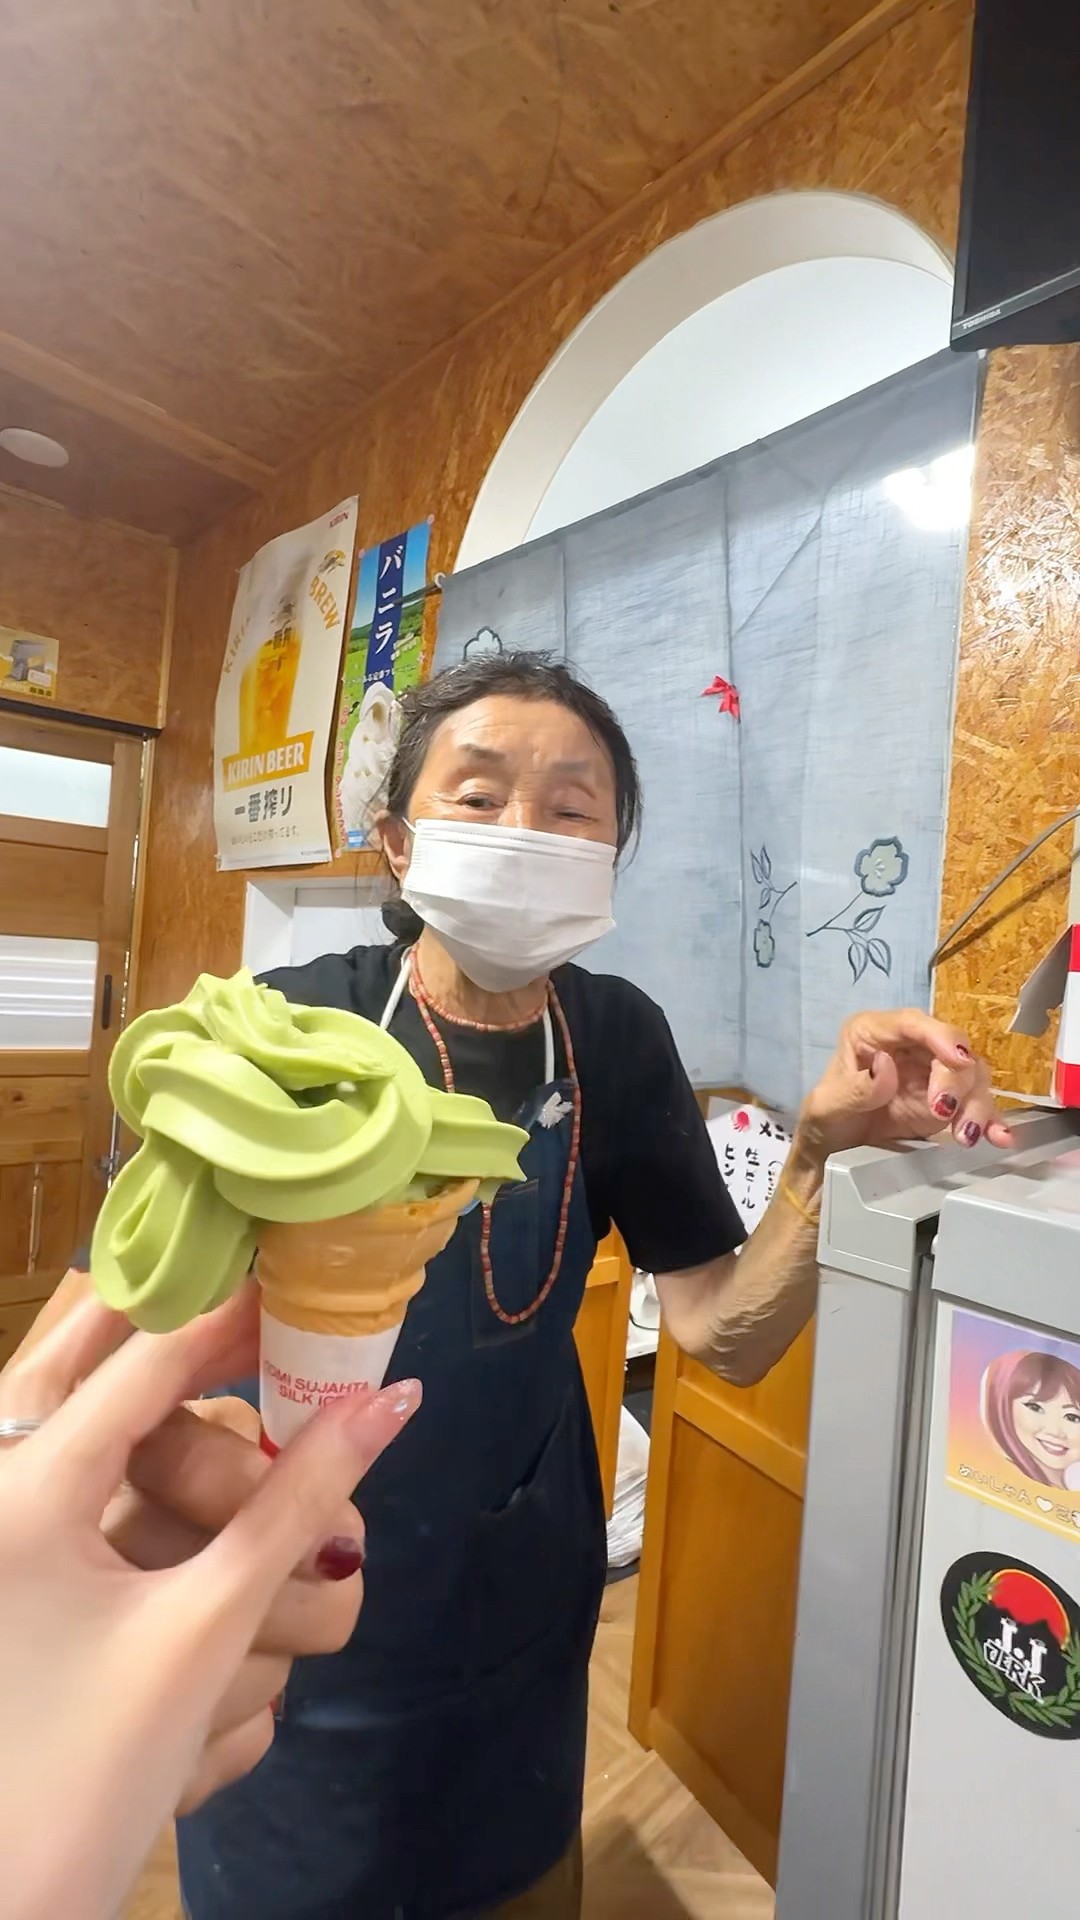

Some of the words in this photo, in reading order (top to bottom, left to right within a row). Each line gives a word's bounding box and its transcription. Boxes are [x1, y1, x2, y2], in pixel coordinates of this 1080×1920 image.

[309, 575, 341, 630] BREW
[374, 544, 404, 655] バニラ
[228, 754, 265, 785] KIRIN
[266, 742, 305, 774] BEER
[234, 785, 293, 823] 一番搾り
[279, 1385, 313, 1407] SILK
[318, 1395, 345, 1408] IC
[295, 1378, 369, 1394] SUJAHTA
